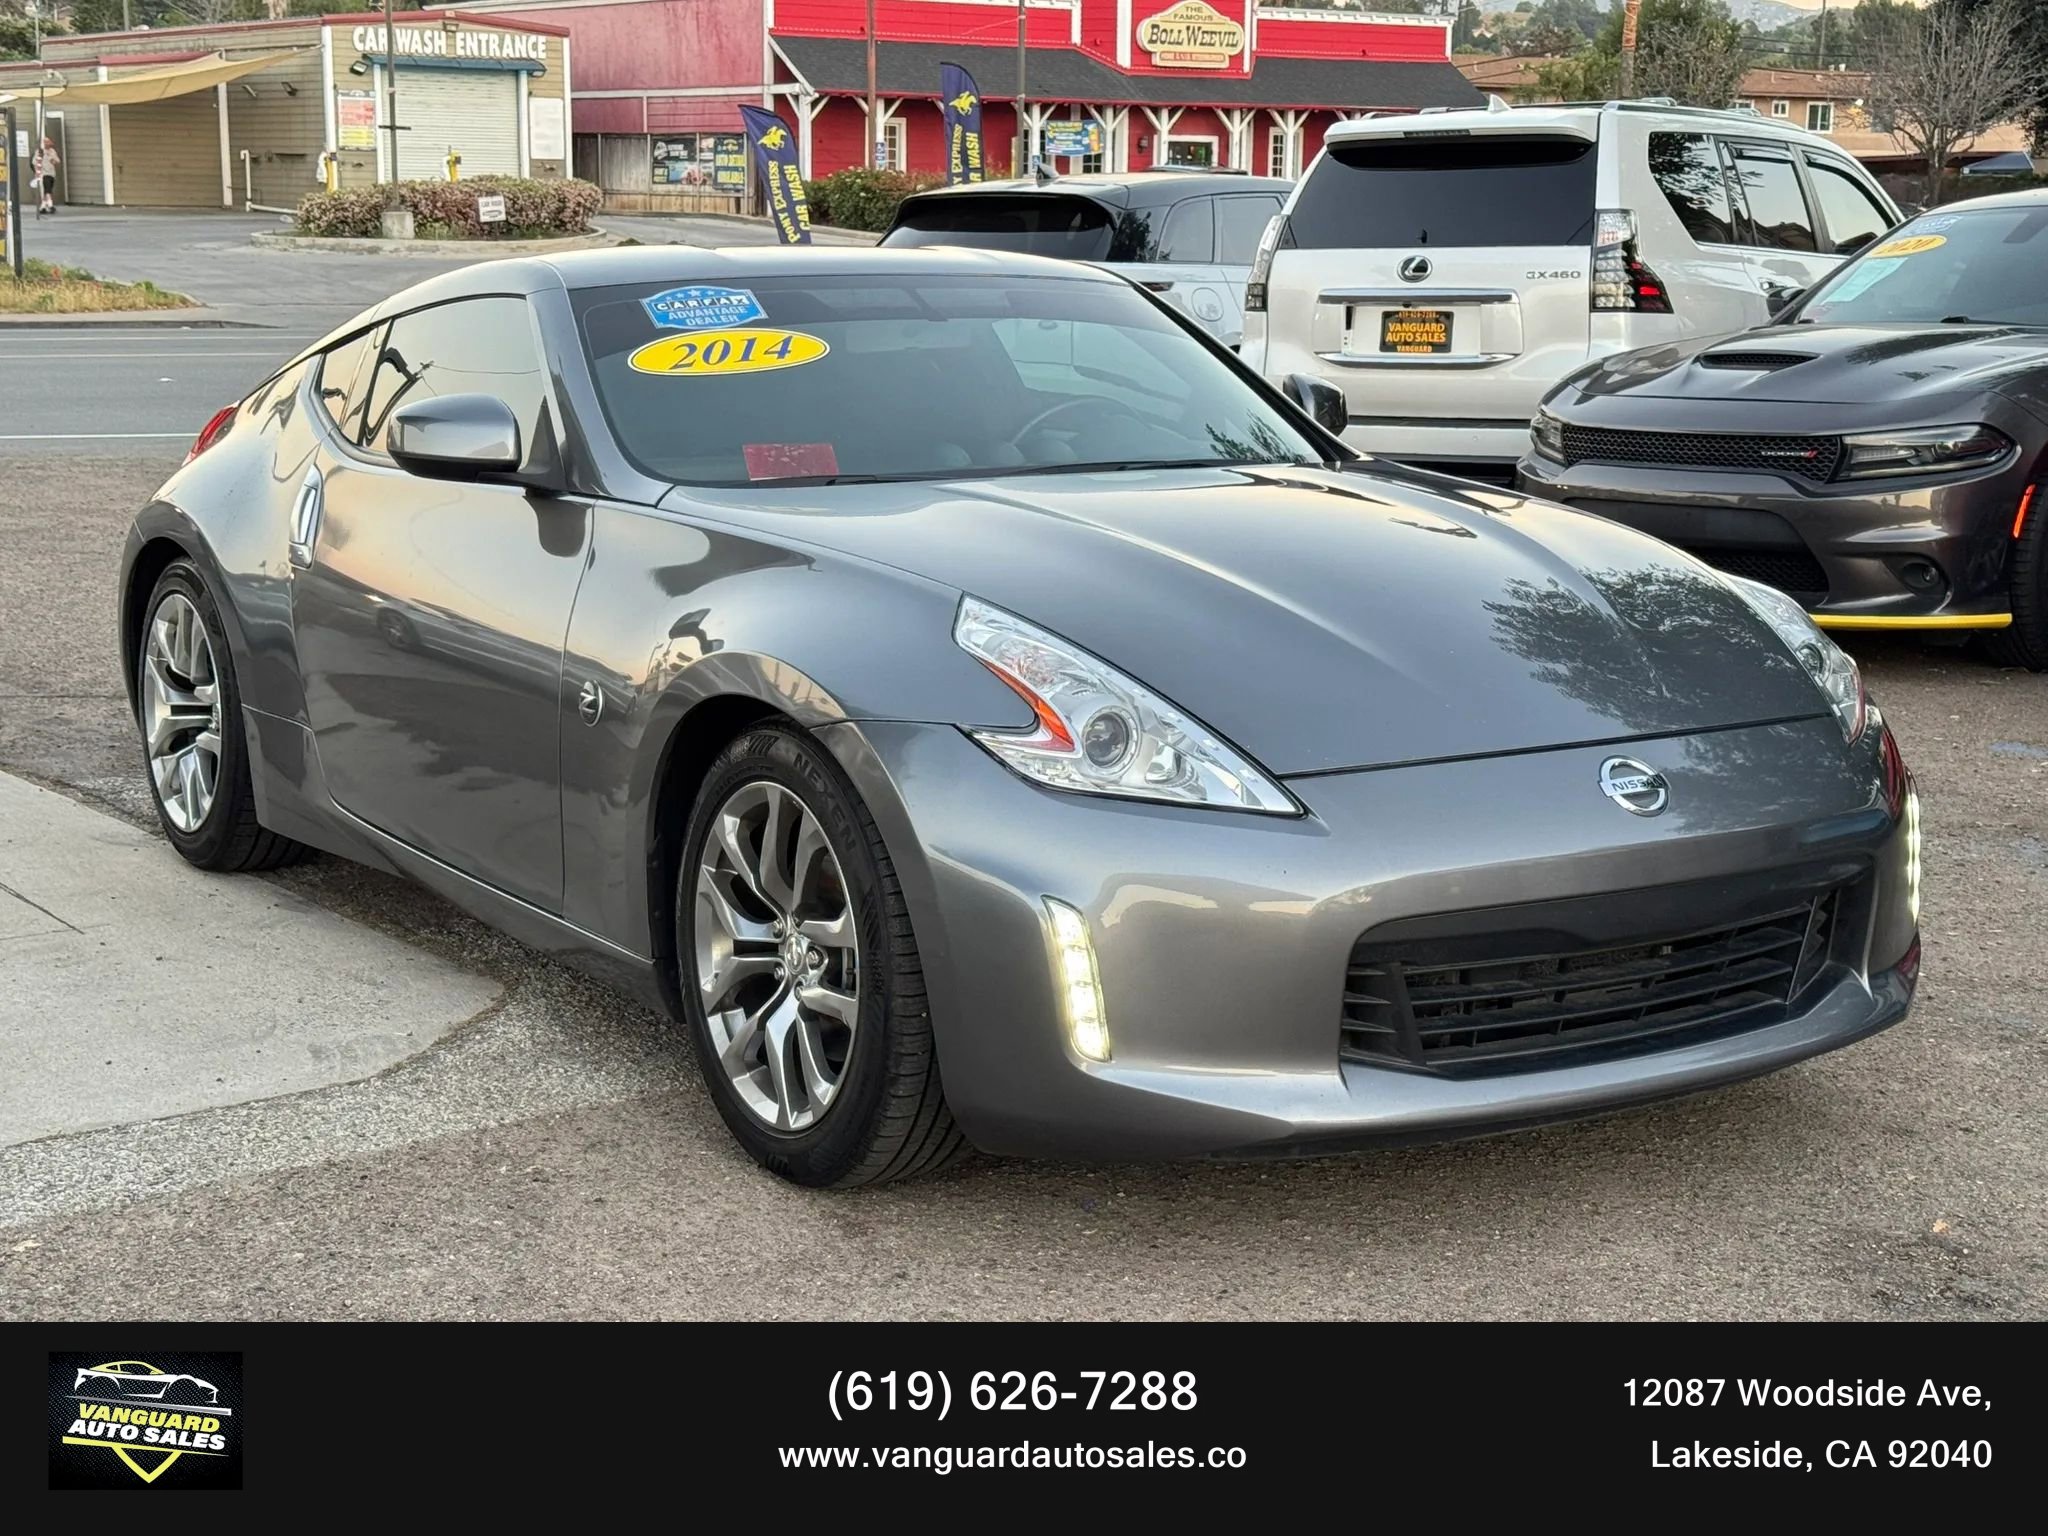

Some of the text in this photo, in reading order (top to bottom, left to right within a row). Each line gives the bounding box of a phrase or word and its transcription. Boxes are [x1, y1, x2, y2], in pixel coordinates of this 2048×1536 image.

[1173, 13, 1214, 21] FAMOUS
[352, 27, 548, 59] CAR WASH ENTRANCE
[1148, 23, 1239, 48] BOLL WEEVIL
[965, 132, 981, 169] WASH
[768, 160, 801, 244] PONY EXPRESS
[783, 164, 811, 231] CAR WASH
[653, 295, 751, 313] CARFAX
[668, 305, 749, 321] ADVANTAGE
[686, 314, 740, 327] DEALER
[1388, 322, 1446, 333] VANGUARD
[1385, 332, 1447, 343] AUTO SALES
[669, 334, 794, 370] 2014
[793, 751, 858, 851] NEXEN
